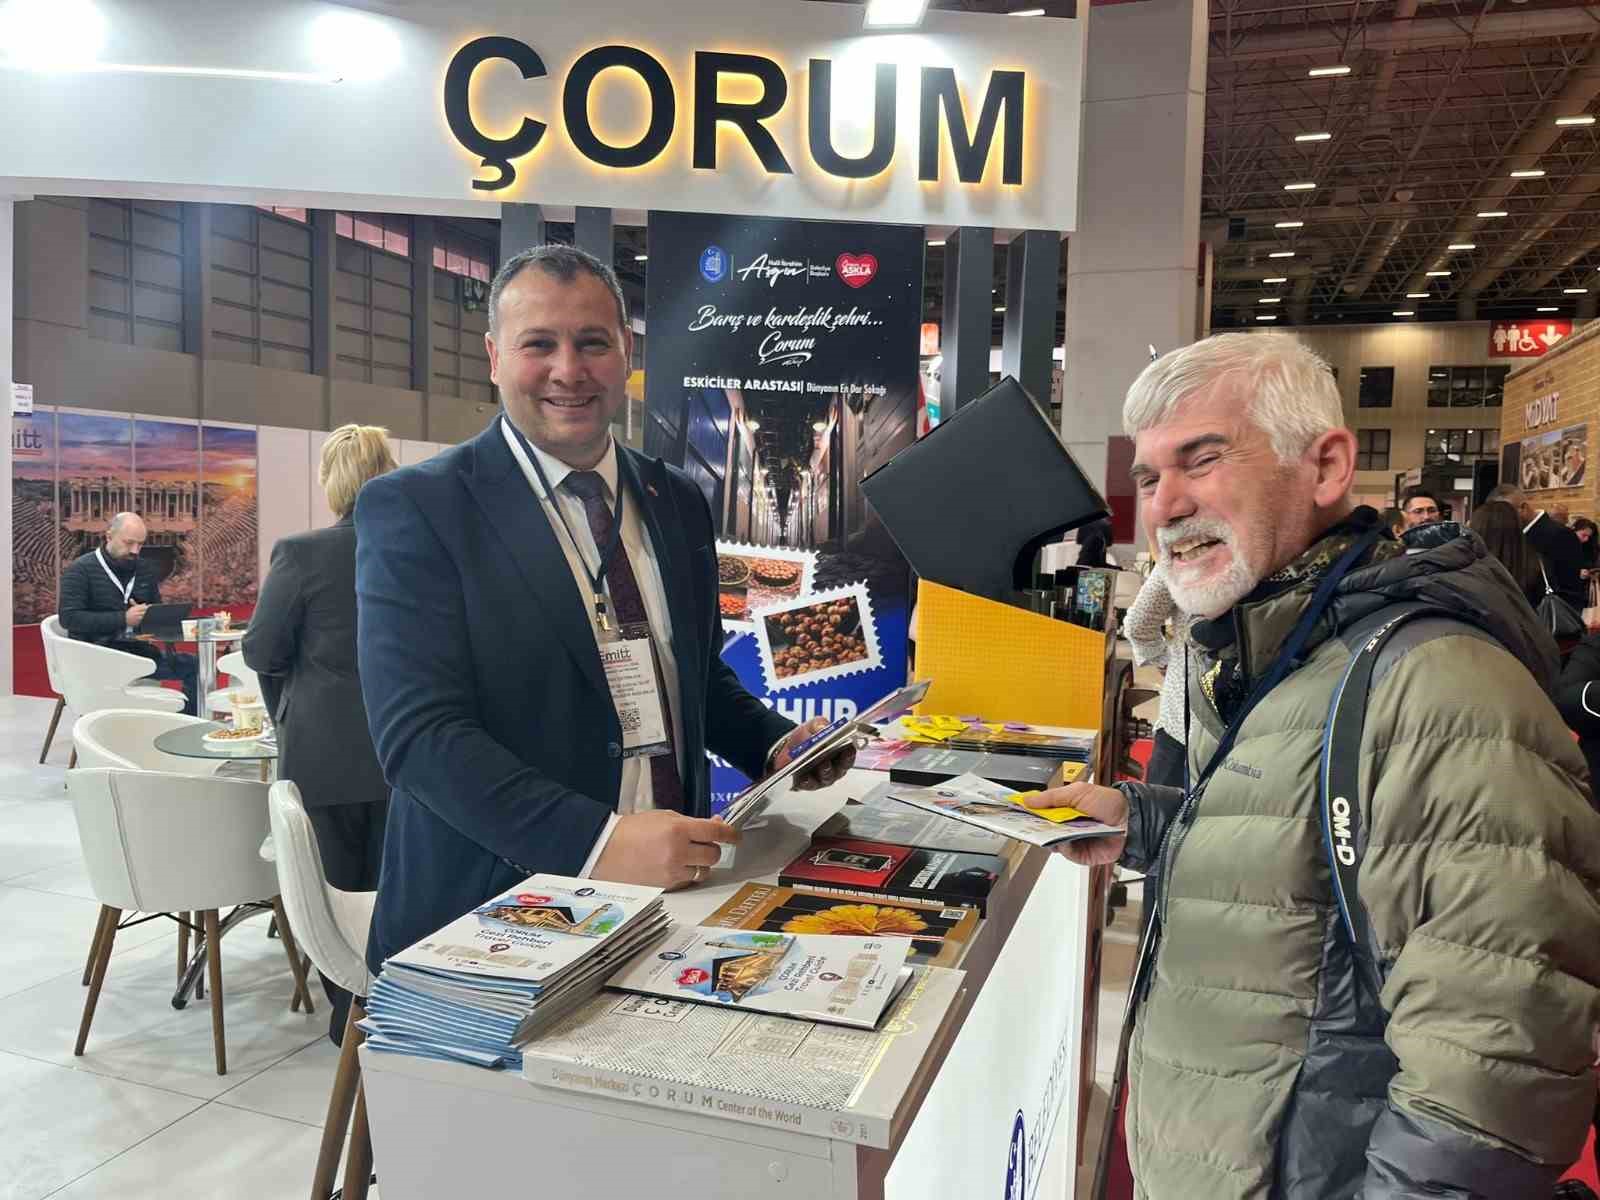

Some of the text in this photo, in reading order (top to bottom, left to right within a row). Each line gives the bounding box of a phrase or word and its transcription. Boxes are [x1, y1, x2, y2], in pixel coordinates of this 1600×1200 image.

[444, 36, 1025, 190] ÇORUM
[688, 304, 744, 332] Barış
[747, 314, 763, 327] ve
[765, 306, 832, 333] kardeşlik
[683, 375, 741, 390] ESKİCİLER
[1332, 796, 1356, 867] OM-D
[718, 1100, 746, 1114] Center
[747, 1103, 757, 1116] of
[758, 1104, 773, 1121] the
[774, 1109, 802, 1126] World
